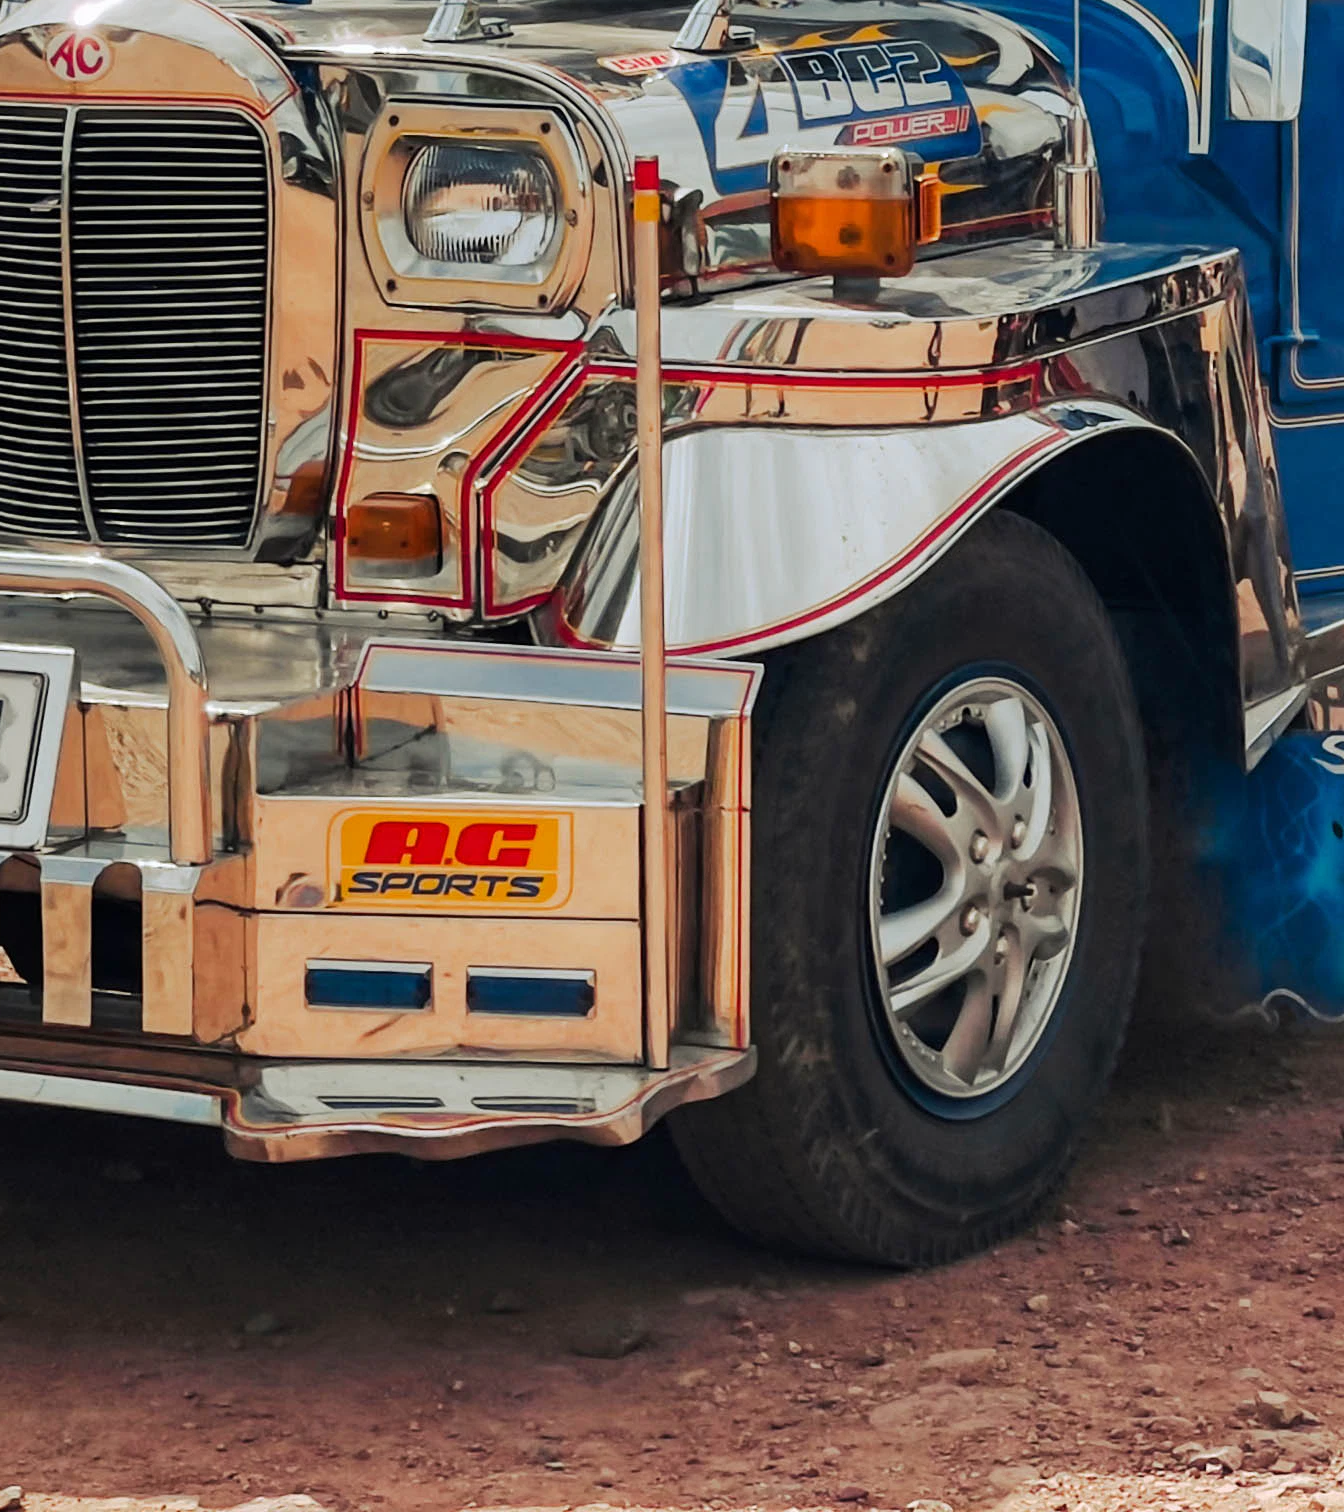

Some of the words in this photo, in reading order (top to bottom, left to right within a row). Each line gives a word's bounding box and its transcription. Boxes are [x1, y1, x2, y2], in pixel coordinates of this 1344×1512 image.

[49, 33, 104, 79] AC
[853, 113, 956, 143] POWER
[363, 821, 538, 867] A.C
[347, 871, 545, 897] SPORTS
